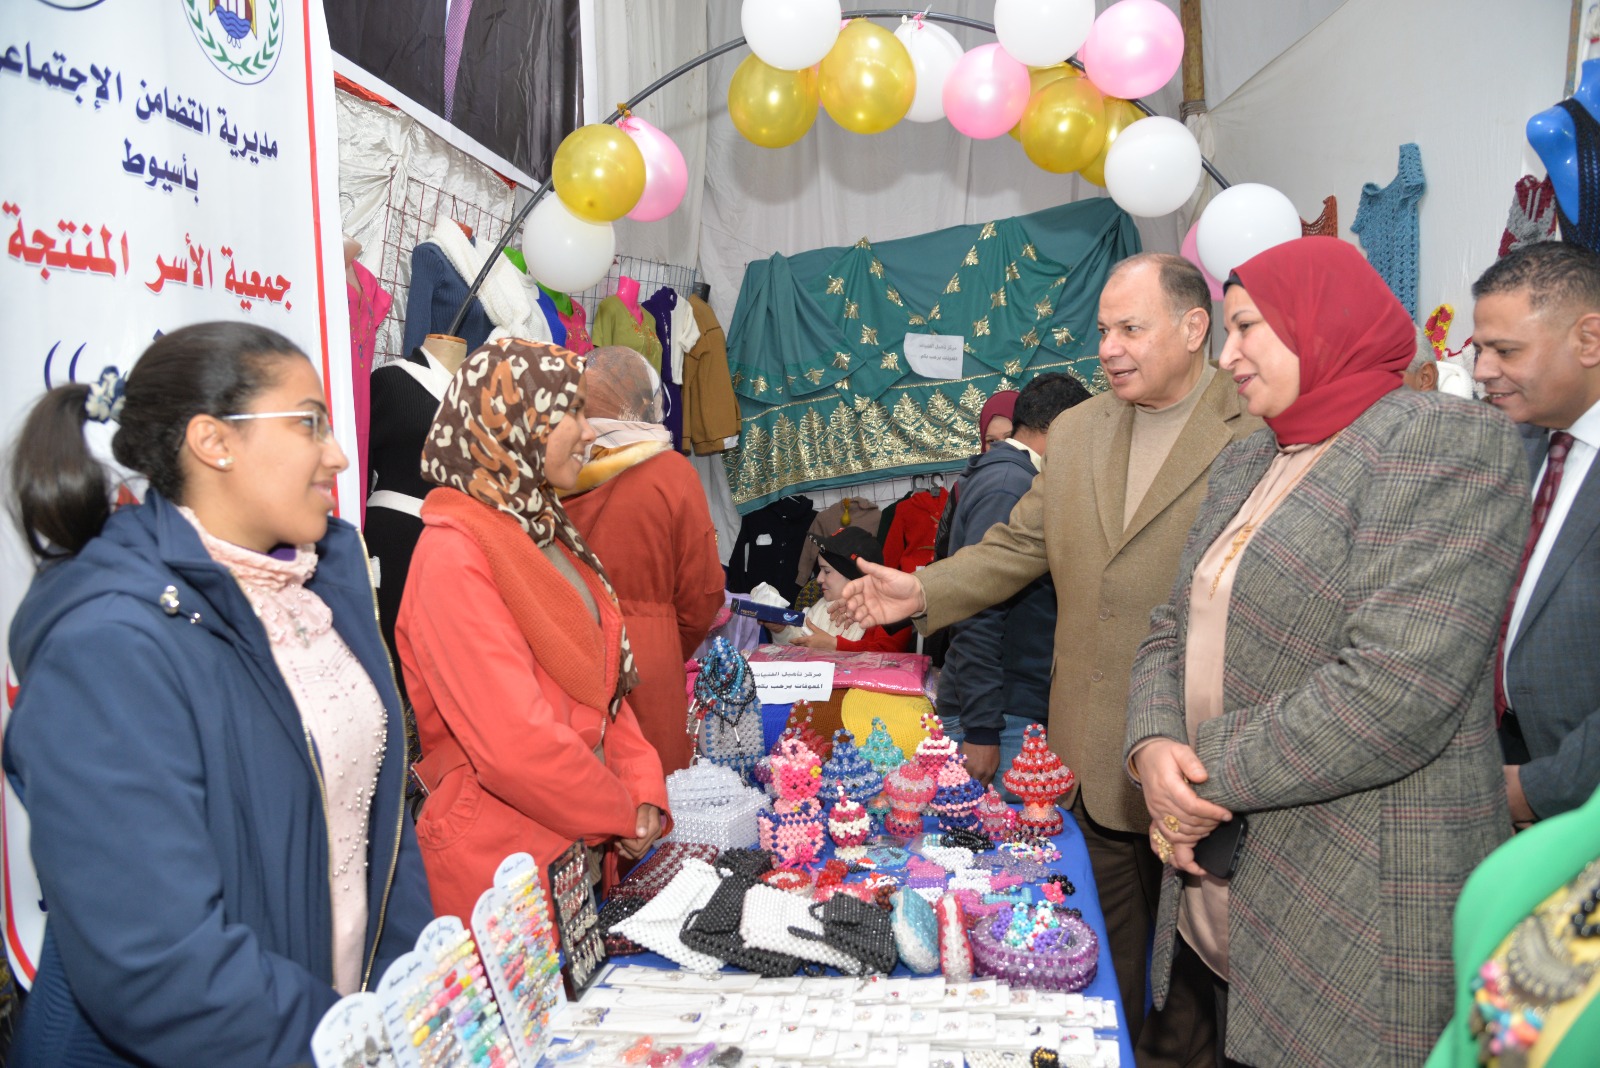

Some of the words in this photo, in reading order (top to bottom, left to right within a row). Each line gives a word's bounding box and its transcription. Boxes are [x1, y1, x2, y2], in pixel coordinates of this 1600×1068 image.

[135, 79, 211, 136] التضامن
[218, 106, 279, 164] مديرية
[122, 138, 200, 204] بأسيوط
[1, 200, 131, 281] المنتجة
[145, 232, 214, 294] الأسر
[220, 245, 292, 311] جمعية
